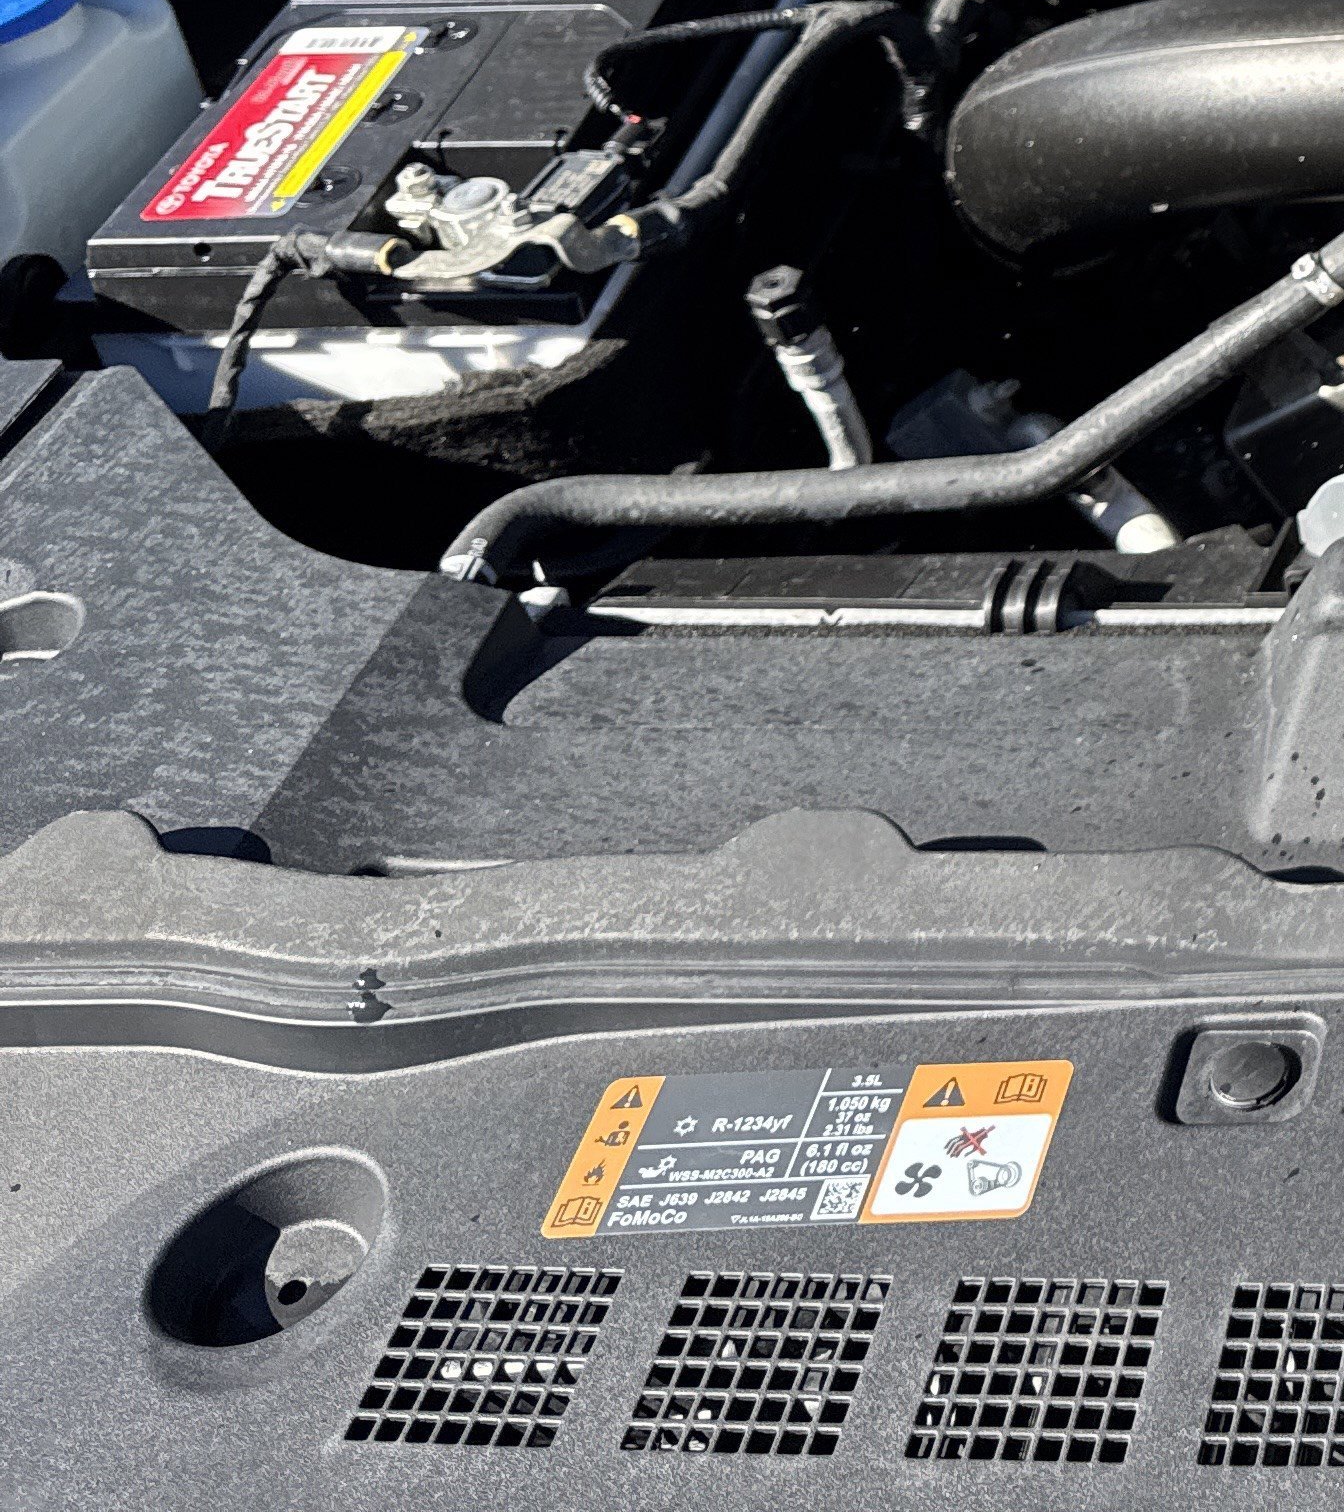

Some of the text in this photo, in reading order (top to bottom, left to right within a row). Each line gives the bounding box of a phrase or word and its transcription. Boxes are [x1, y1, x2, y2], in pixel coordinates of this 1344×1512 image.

[172, 141, 229, 195] TOYOTA
[852, 1074, 882, 1088] 3.5L
[828, 1096, 892, 1113] 1.050 kg
[711, 1114, 793, 1133] R-1234yf
[836, 1111, 872, 1124] 37 oz
[823, 1123, 874, 1137] 2.31 lbs
[740, 1148, 781, 1165] PAG
[806, 1142, 874, 1158] 6.1 fl oz
[669, 1166, 775, 1182] WSS-M2C300-A2
[800, 1157, 868, 1177] (180 cc)
[617, 1194, 653, 1209] SAE
[659, 1192, 699, 1207] J639
[607, 1208, 688, 1227] FoMoCo
